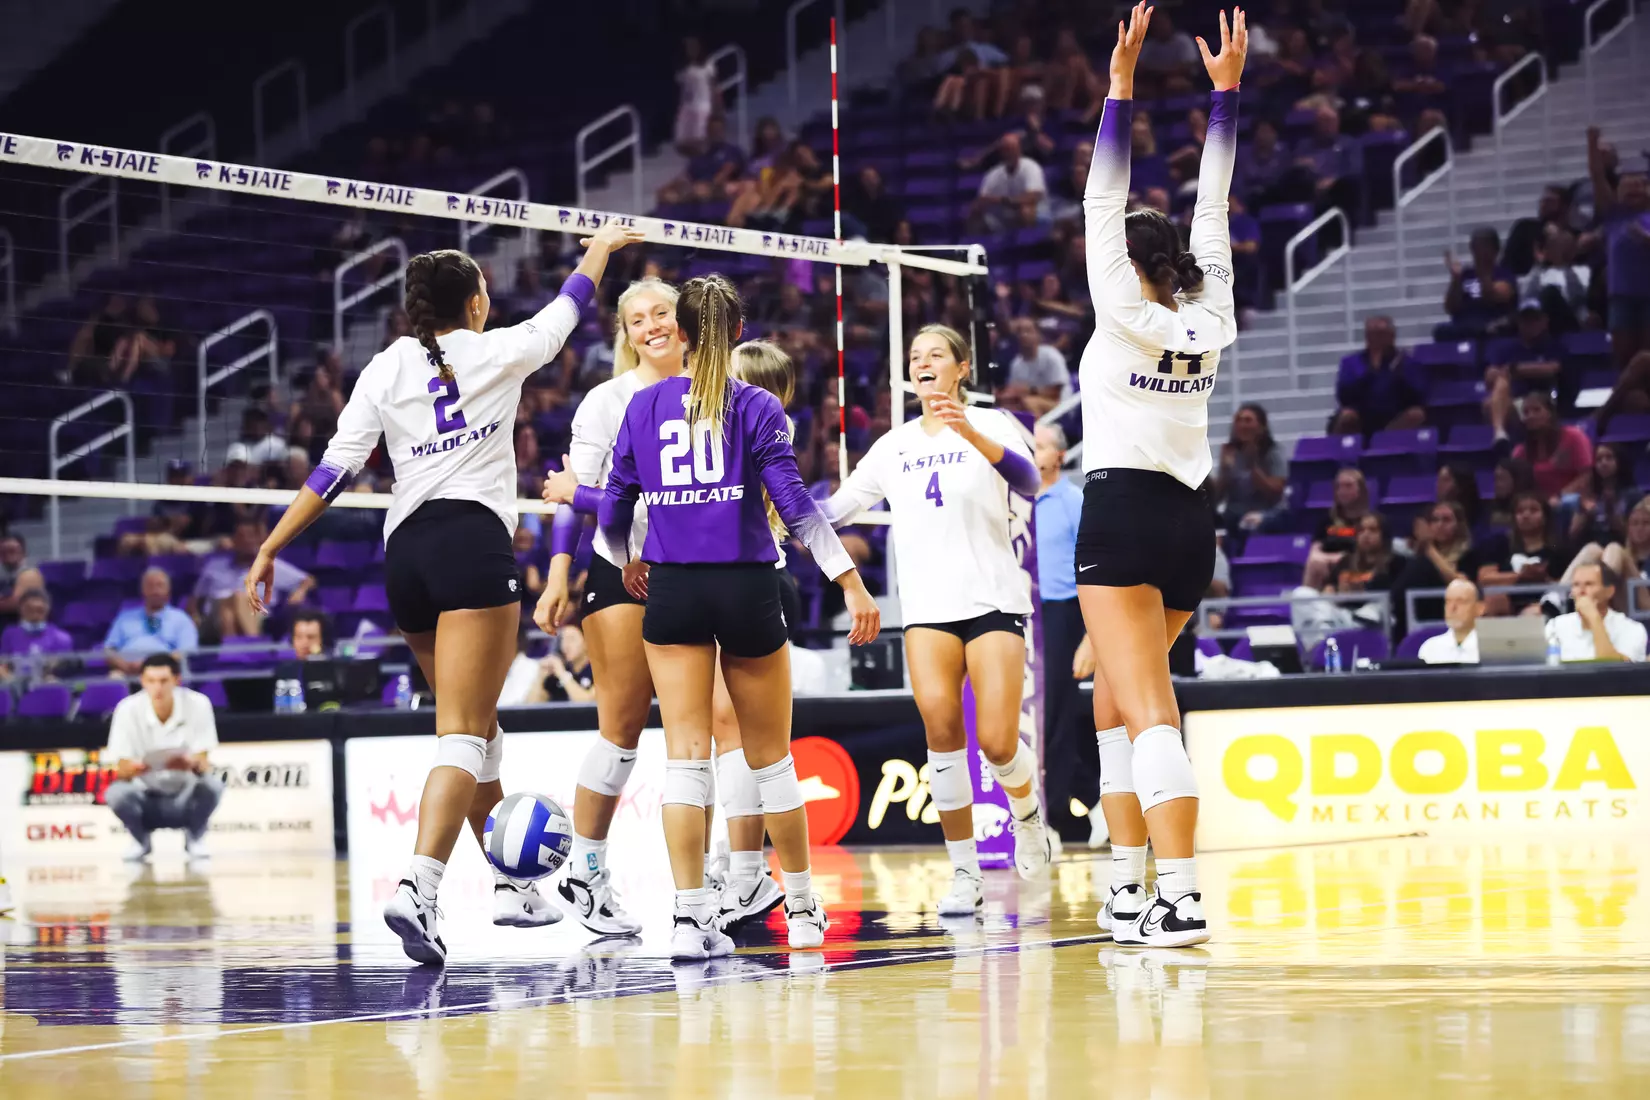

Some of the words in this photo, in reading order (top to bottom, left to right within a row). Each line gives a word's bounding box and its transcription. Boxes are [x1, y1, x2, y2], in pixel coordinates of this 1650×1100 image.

[80, 146, 161, 174] K-STATE
[218, 164, 293, 191] K-STATE
[346, 182, 415, 206] K-STATE
[465, 197, 530, 221] K-STATE
[680, 224, 737, 245] K-STATE
[777, 236, 831, 256] K-STATE
[1129, 372, 1215, 394] WILDCATS
[427, 375, 468, 435] 2
[659, 418, 725, 487] 20
[902, 450, 969, 473] K-STATE
[1090, 471, 1108, 482] PRO
[639, 484, 745, 506] WILDCATS
[925, 471, 944, 508] 4
[1222, 726, 1637, 823] QDOBA
[1312, 802, 1500, 823] MEXICAN
[1525, 799, 1629, 819] EATS
[26, 822, 97, 842] GMC
